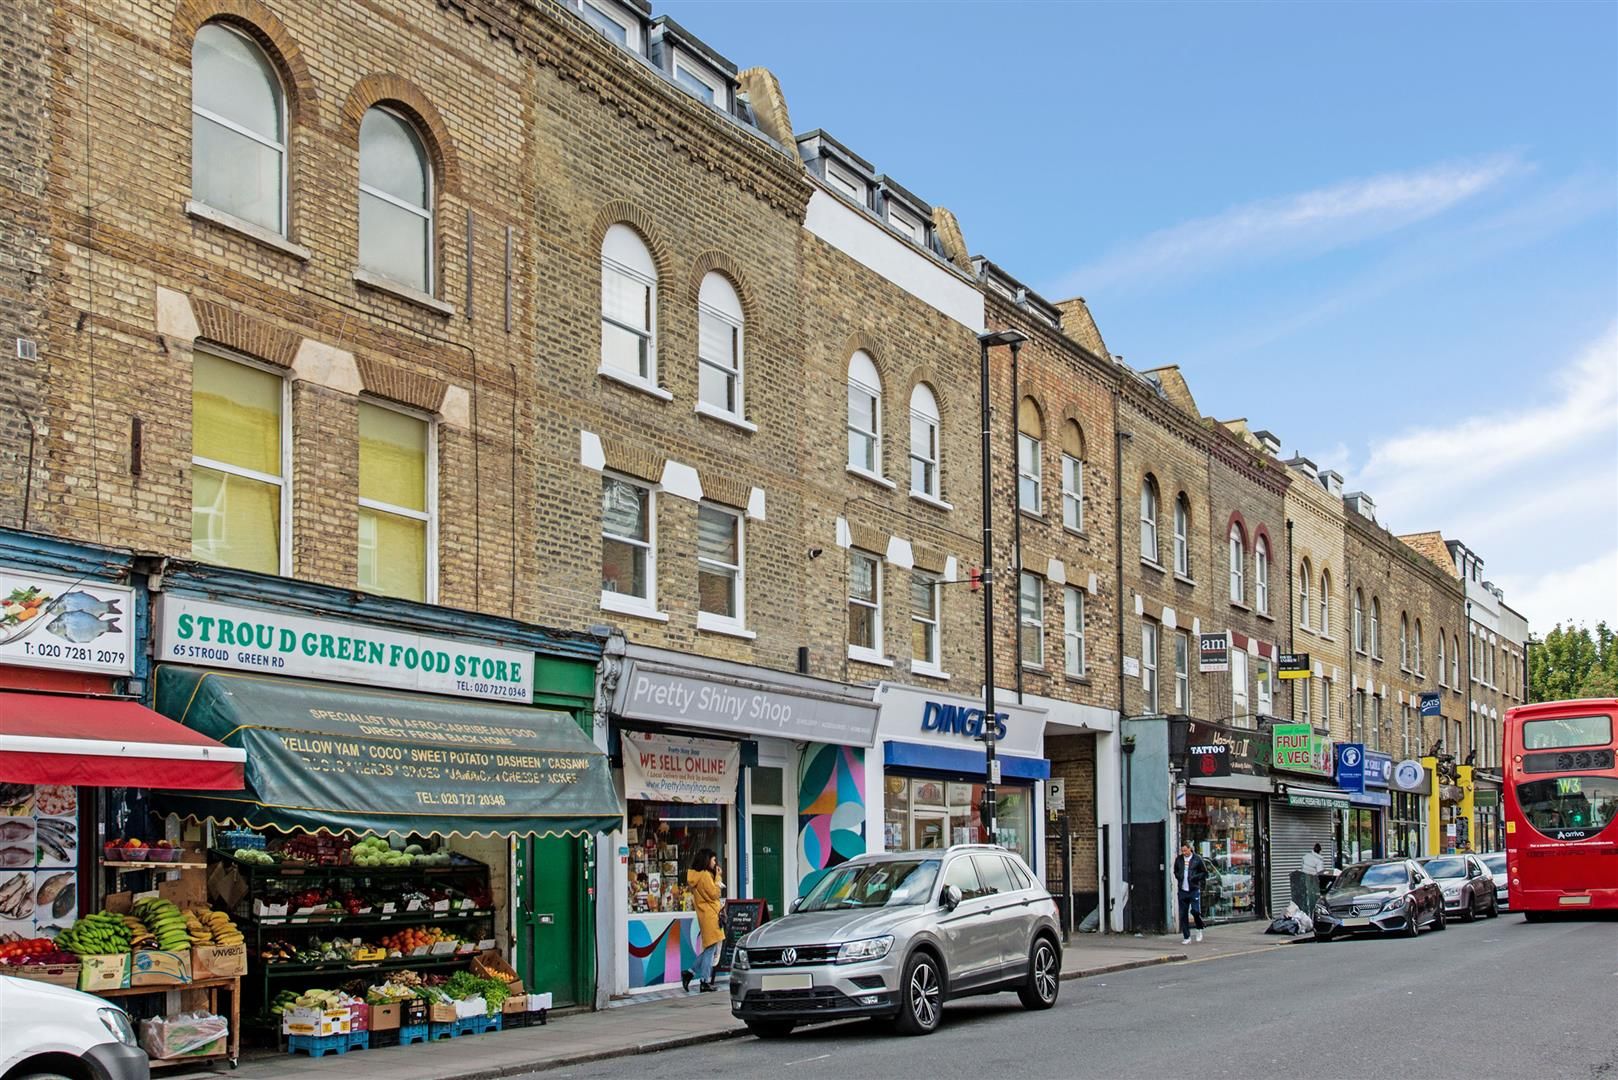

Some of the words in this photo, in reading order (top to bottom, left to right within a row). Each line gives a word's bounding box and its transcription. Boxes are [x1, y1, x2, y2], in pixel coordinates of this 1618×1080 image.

[24, 642, 35, 656] T:
[38, 644, 60, 658] 020
[64, 646, 92, 661] 7281
[96, 650, 125, 664] 2079
[177, 613, 297, 652] STROUD
[302, 632, 384, 664] GREEN
[390, 644, 450, 673] FOOD
[454, 658, 522, 683] STORE
[1202, 639, 1226, 650] am
[173, 644, 186, 656] 65
[188, 646, 230, 661] STROUD
[237, 652, 270, 666] GREEN
[272, 655, 284, 668] RD
[456, 680, 472, 692] TEL:
[474, 682, 488, 694] 020
[490, 684, 507, 696] 7272
[508, 686, 526, 698] 0348
[634, 677, 696, 714] Pretty
[698, 687, 748, 721] Shiny
[750, 695, 792, 726] Shop
[1421, 698, 1440, 708] CATS
[309, 708, 386, 726] SPECIALIST
[386, 717, 402, 728] IN
[506, 728, 538, 738] FOOD
[921, 701, 1010, 740] DINGLS
[359, 724, 408, 738] DIRECT
[408, 730, 447, 741] FROM
[1190, 745, 1226, 754] TATTOO
[1276, 735, 1308, 748] FRUIT
[280, 736, 332, 754] YELLOW
[336, 742, 360, 757] YAM
[369, 746, 402, 760] COCO
[411, 750, 447, 763] SWEET
[450, 751, 489, 766] POTATO
[496, 754, 541, 768] DASHEEN
[1278, 752, 1284, 764] &
[1287, 751, 1309, 764] VEG
[640, 752, 656, 769] WE
[660, 754, 682, 772] SELL
[685, 756, 726, 774] ONLINE!
[1050, 785, 1060, 796] P
[1559, 778, 1580, 793] W3
[416, 792, 440, 804] TEL:
[440, 792, 458, 804] 020
[459, 793, 476, 805] 727
[478, 794, 506, 806] 20348
